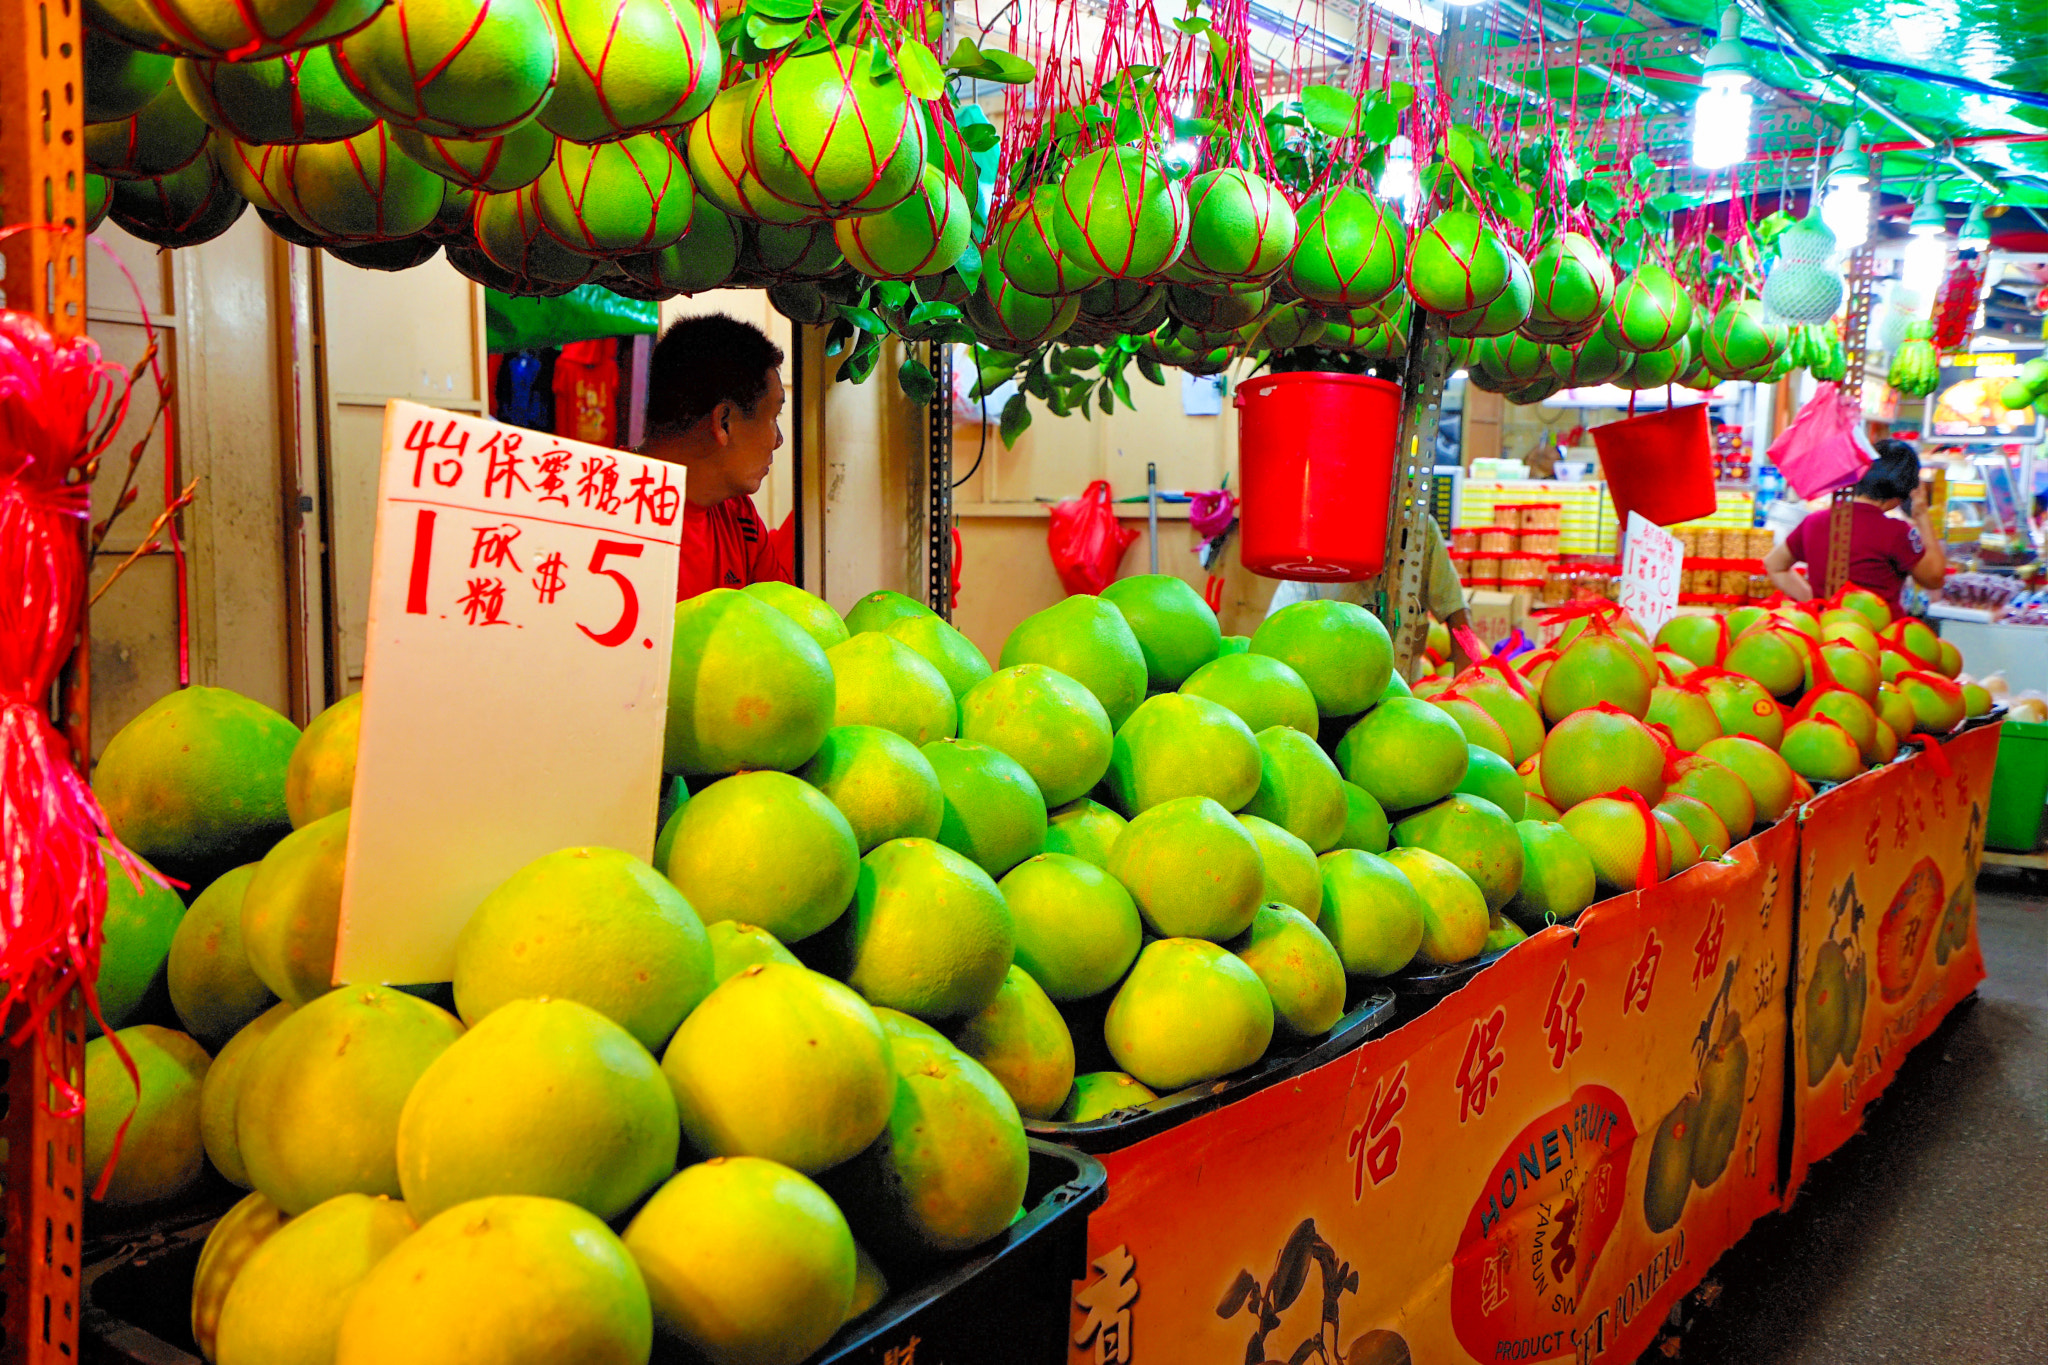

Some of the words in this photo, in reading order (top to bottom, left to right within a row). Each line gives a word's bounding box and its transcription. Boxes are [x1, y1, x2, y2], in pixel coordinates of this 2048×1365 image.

[404, 420, 680, 526] 怡保蜜糖柚
[1531, 1203, 1552, 1296] TAMBUN
[1495, 1331, 1565, 1360] PRODUCT
